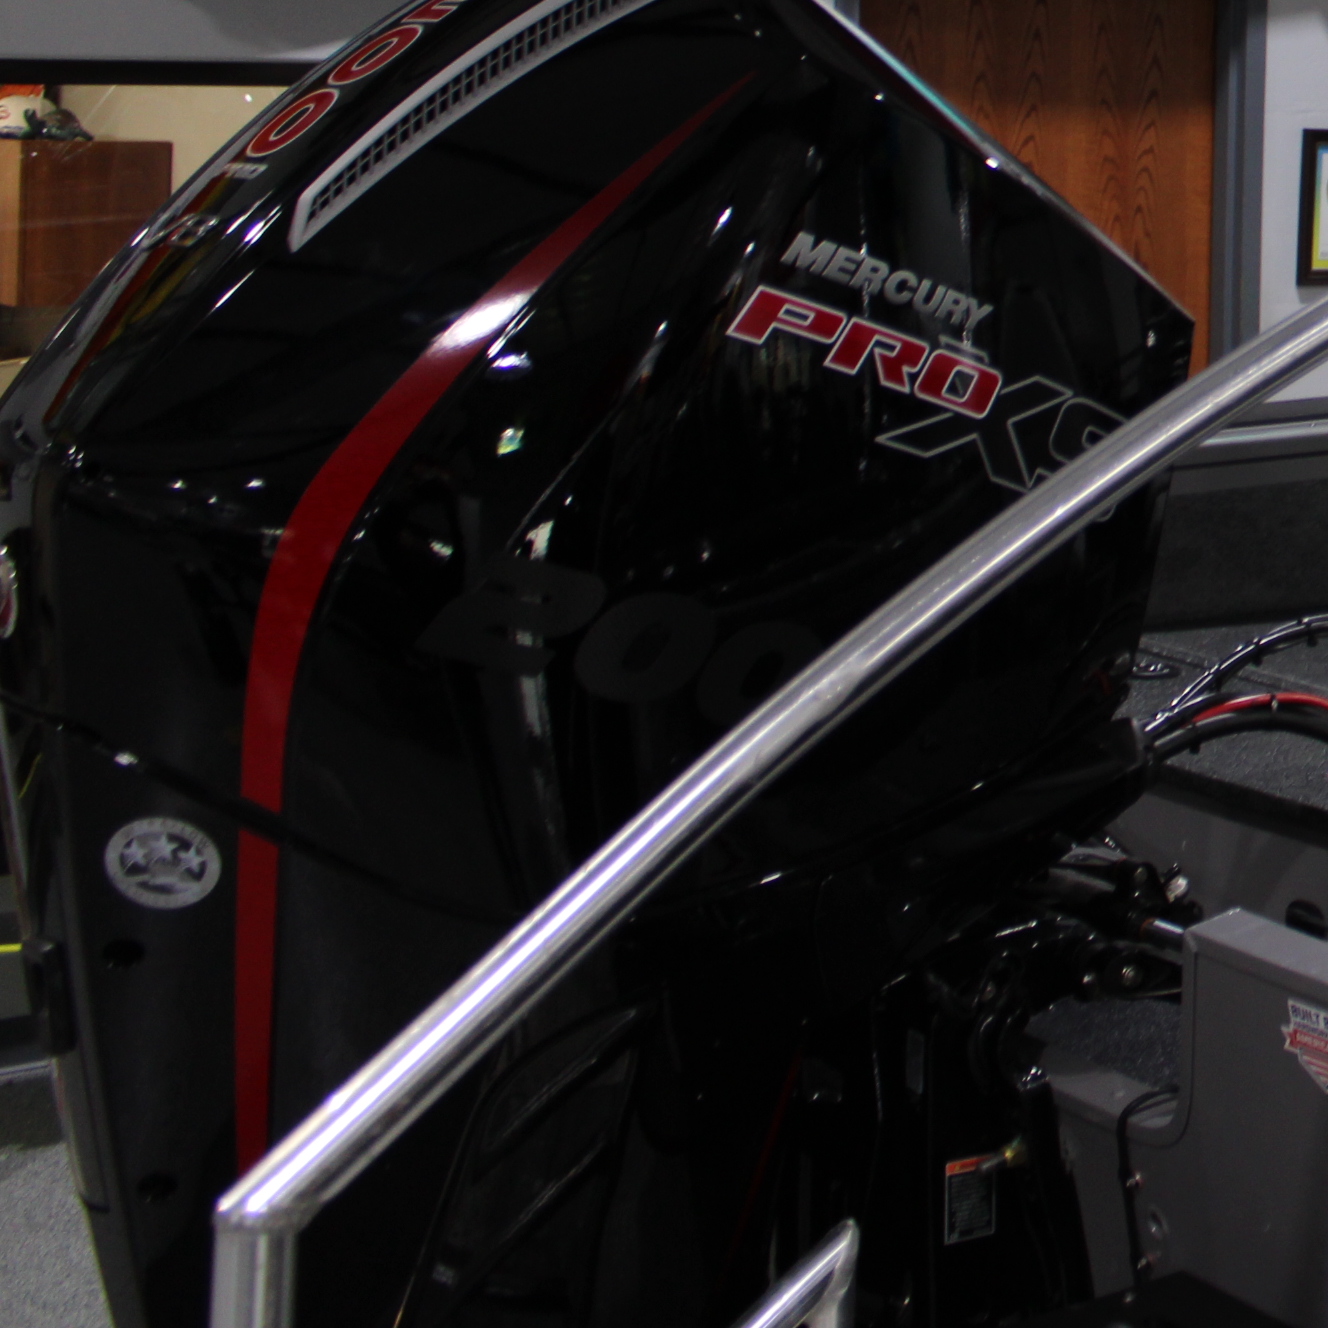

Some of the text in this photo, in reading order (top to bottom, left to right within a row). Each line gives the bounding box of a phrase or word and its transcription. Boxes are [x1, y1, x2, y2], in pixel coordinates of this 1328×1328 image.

[780, 231, 995, 332] MERCURY
[726, 284, 1003, 420] PRO
[1291, 1005, 1320, 1026] BUILT
